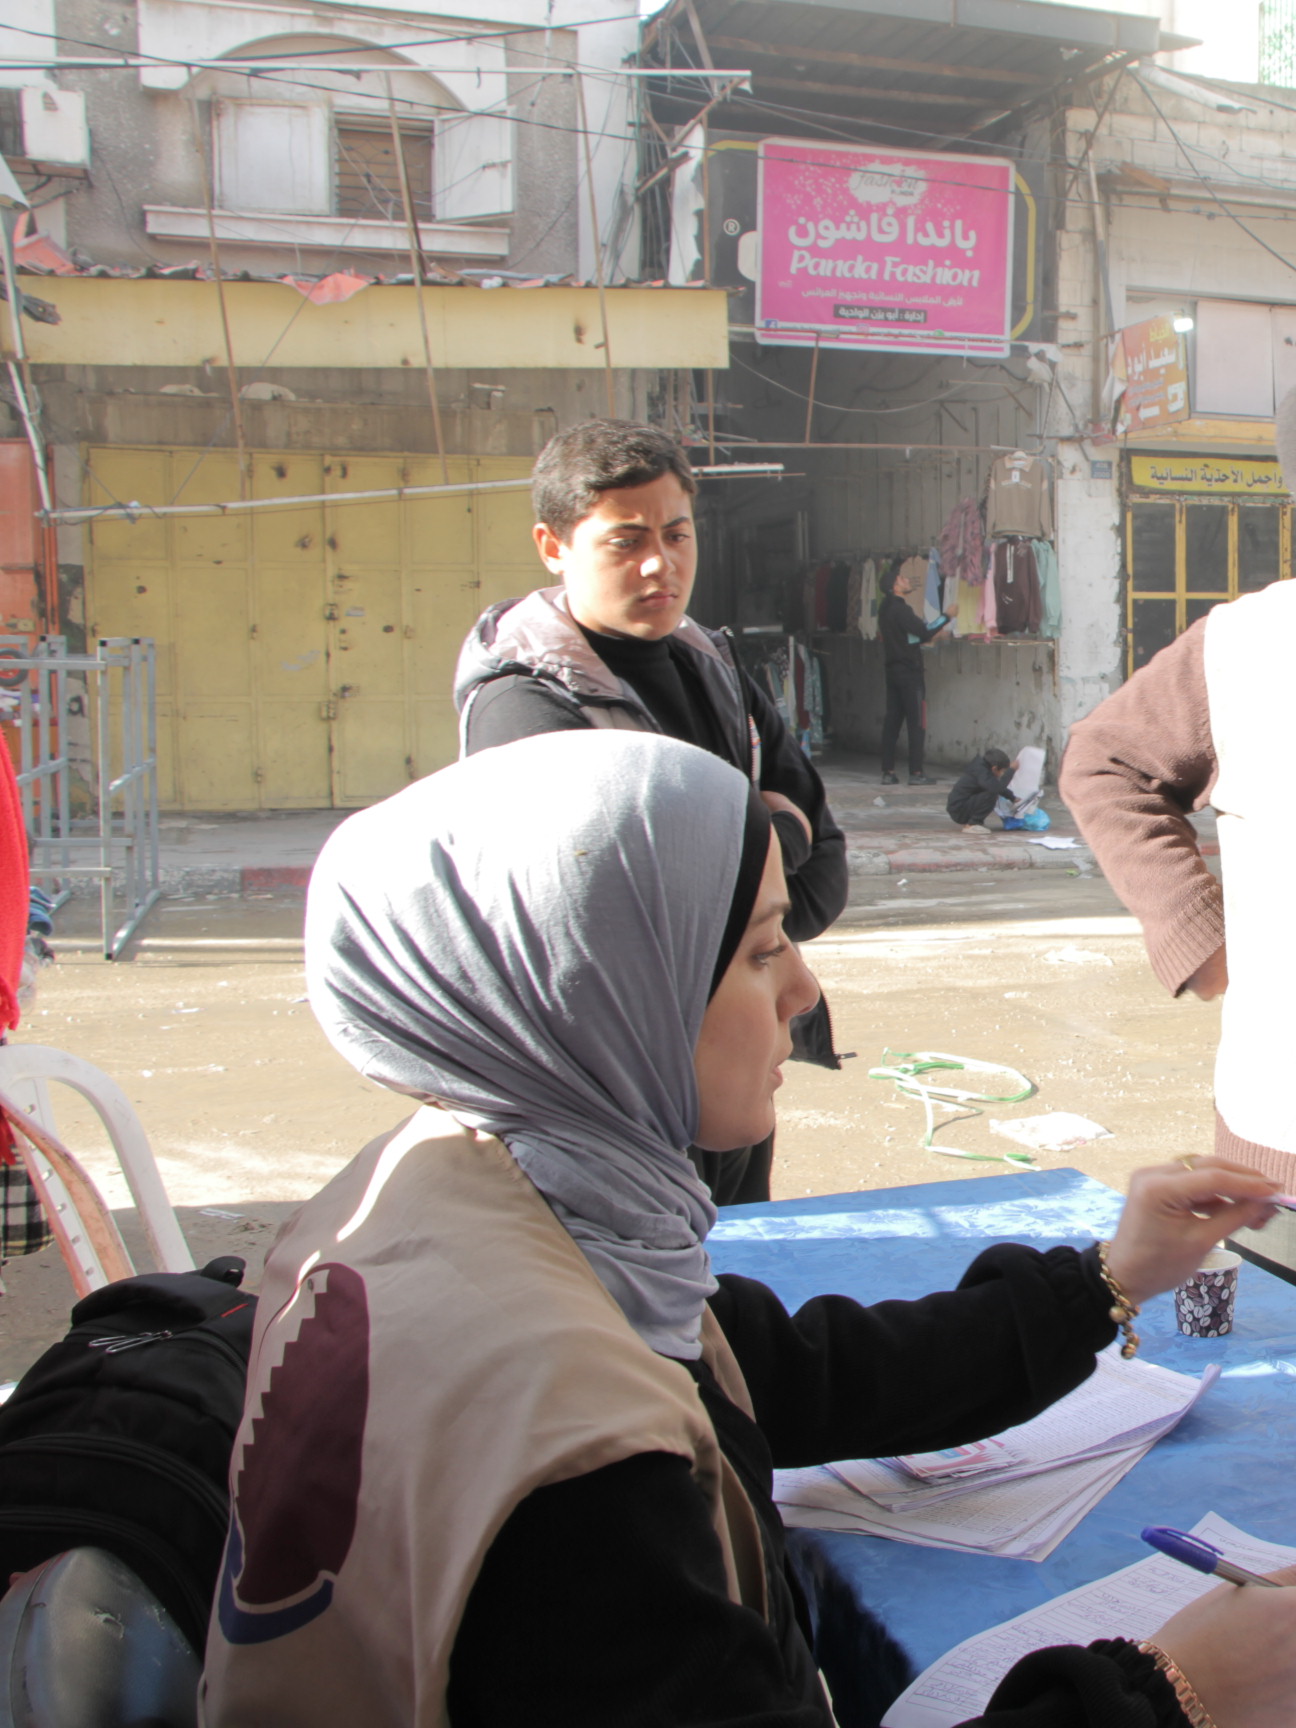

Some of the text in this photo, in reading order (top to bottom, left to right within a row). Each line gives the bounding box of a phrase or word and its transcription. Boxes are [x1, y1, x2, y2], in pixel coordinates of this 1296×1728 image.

[788, 205, 977, 257] باندا فاشون
[789, 249, 980, 288] Panda Fashion
